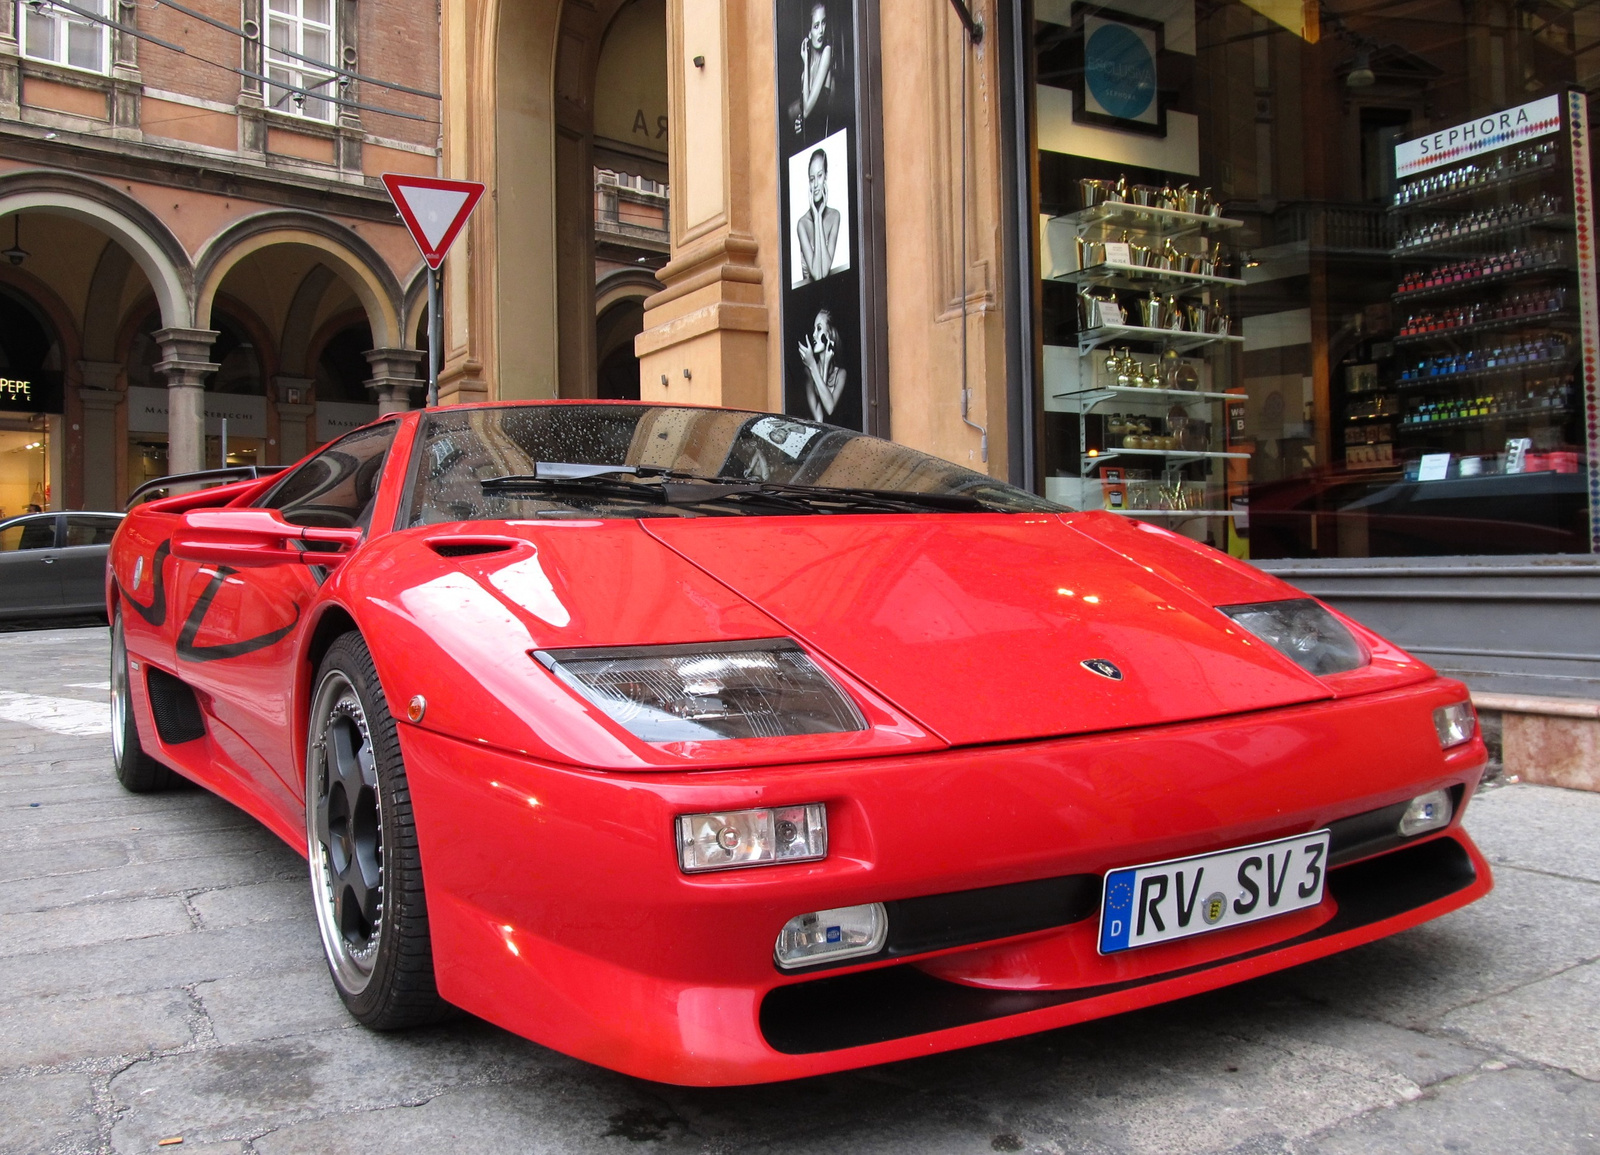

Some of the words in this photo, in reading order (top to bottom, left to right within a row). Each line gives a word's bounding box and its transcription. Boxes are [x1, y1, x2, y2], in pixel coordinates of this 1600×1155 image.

[1420, 108, 1529, 155] SEPHORA
[0, 378, 31, 395] PEPE
[1136, 867, 1204, 936] RV
[1233, 849, 1292, 915] SV
[1298, 842, 1325, 899] 3
[1110, 919, 1122, 937] D
